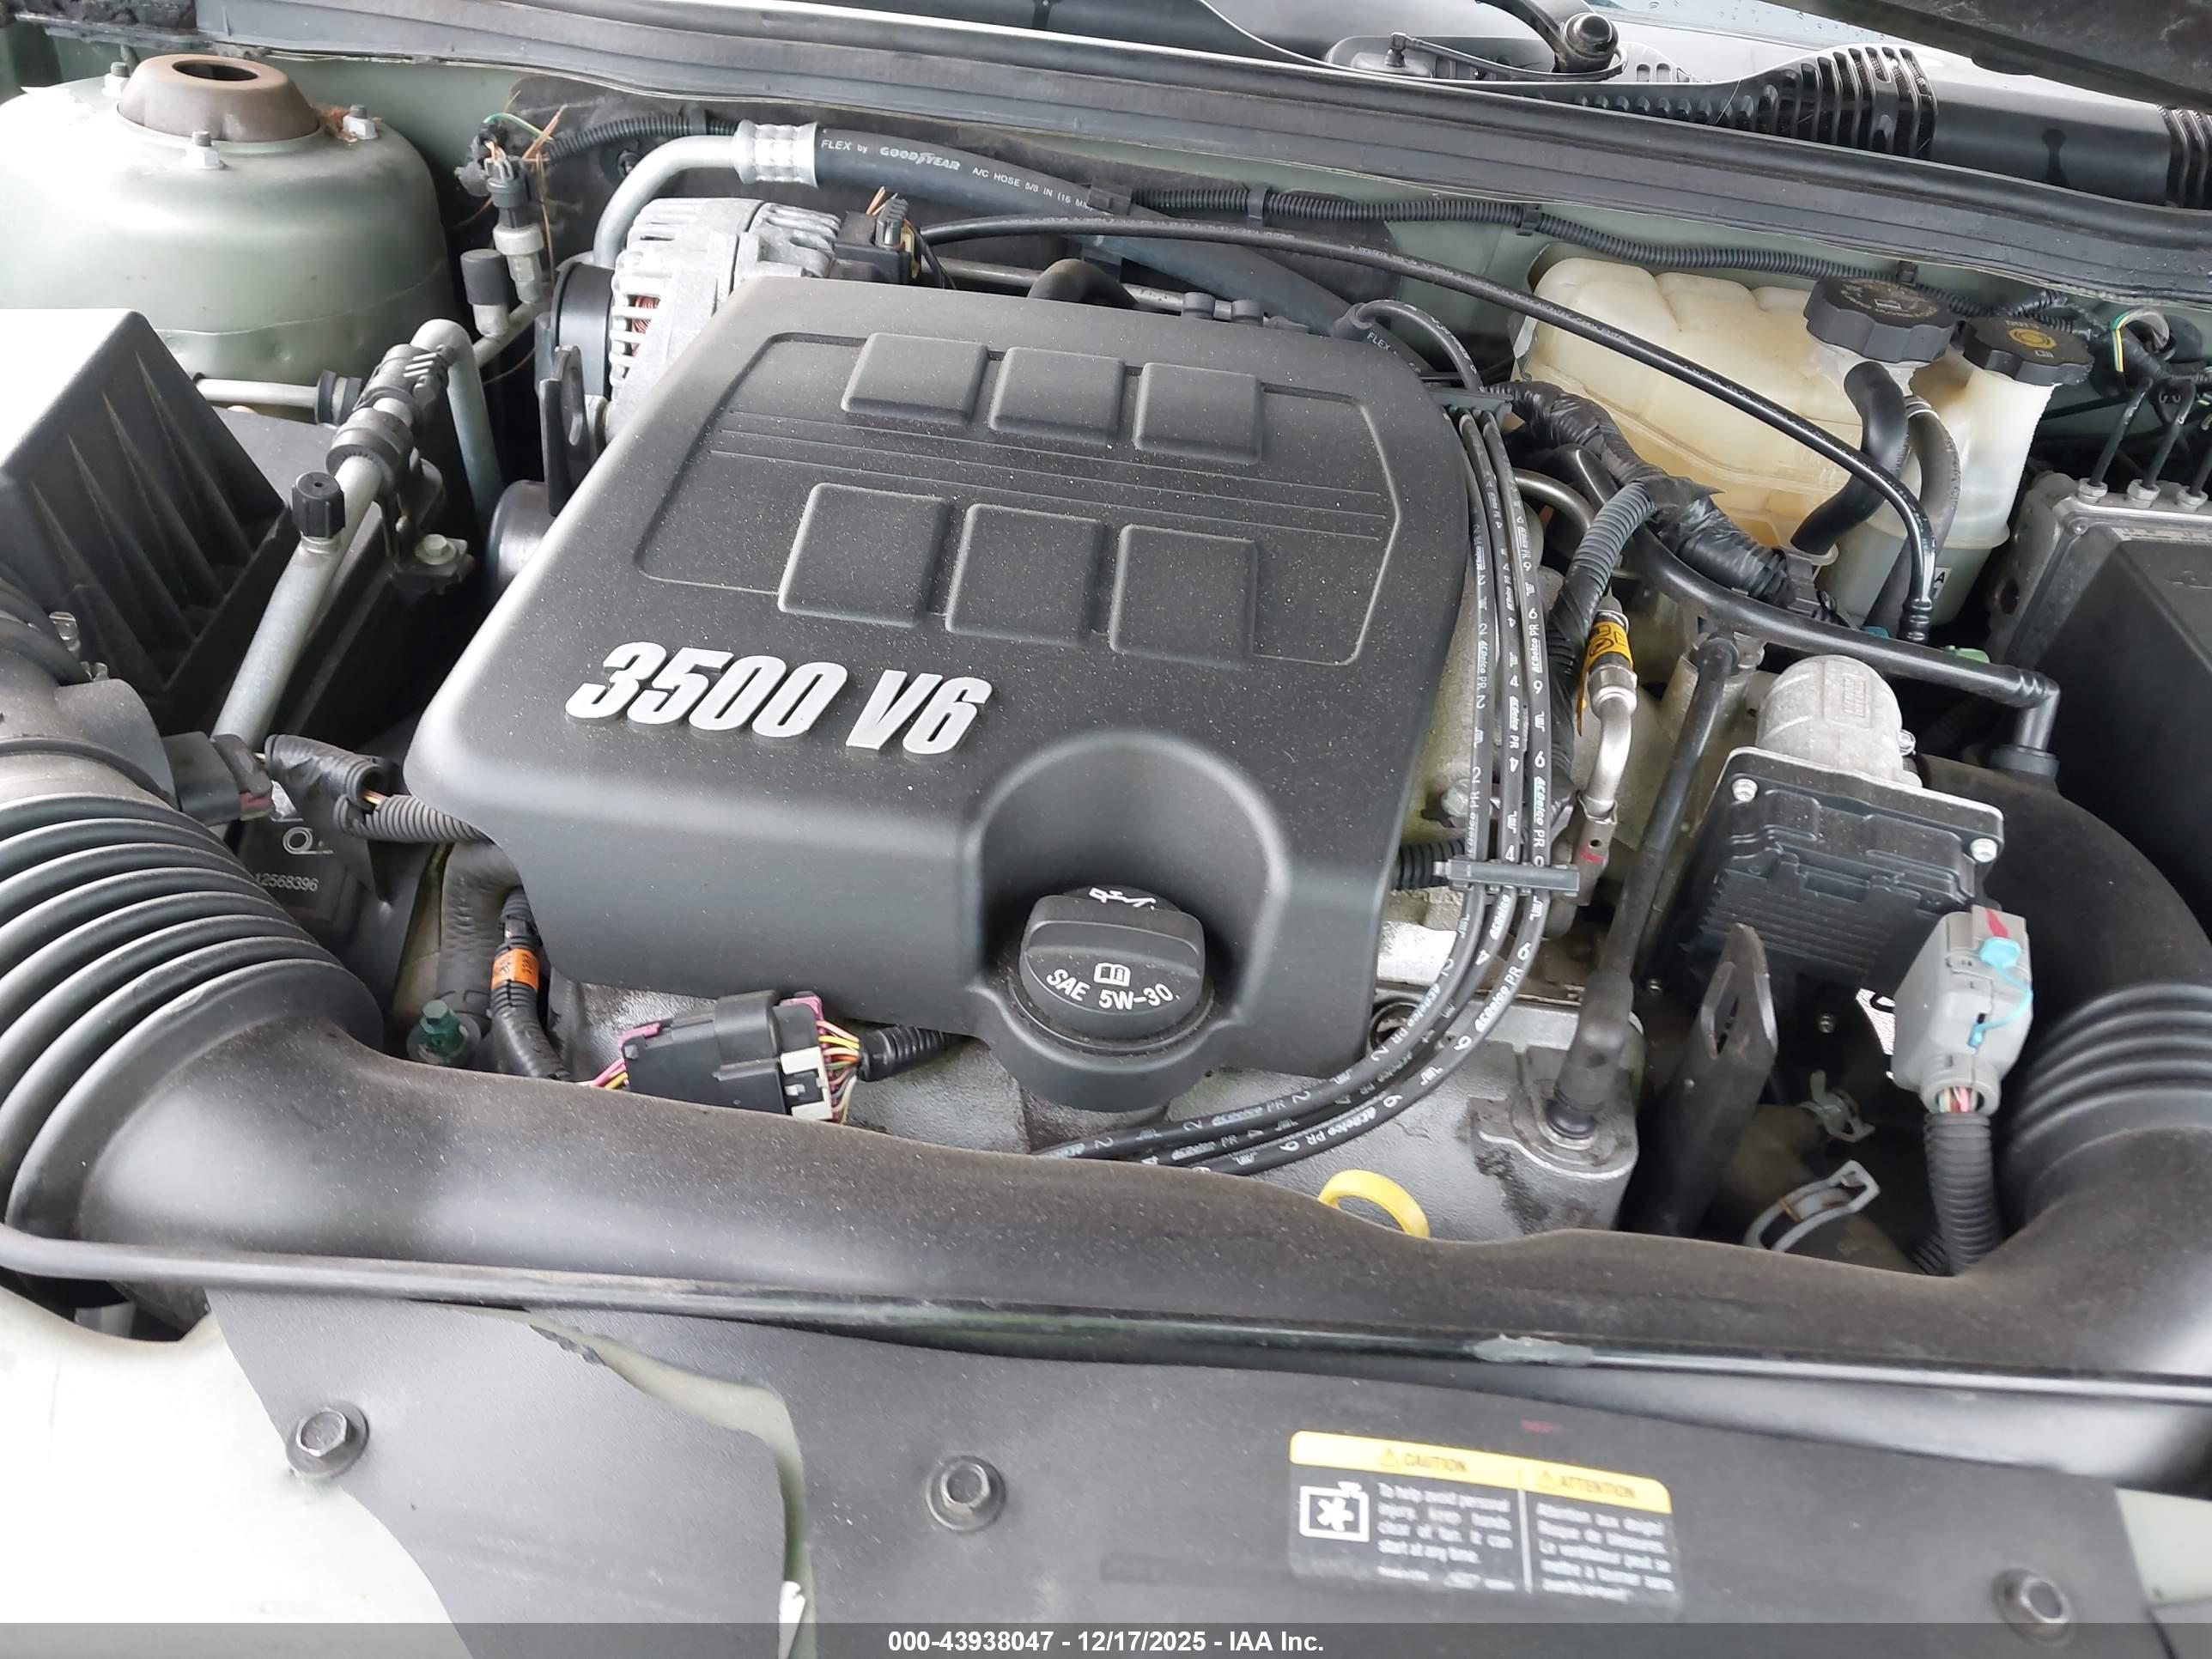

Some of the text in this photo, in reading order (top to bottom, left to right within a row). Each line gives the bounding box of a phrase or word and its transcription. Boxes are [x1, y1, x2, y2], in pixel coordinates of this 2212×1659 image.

[821, 139, 852, 151] FLEX
[857, 143, 868, 155] by
[879, 146, 961, 171] GOODYEAR
[972, 167, 989, 178] A/C
[993, 173, 1021, 187] HOSE
[1024, 182, 1039, 192] 5/8
[1043, 187, 1053, 198] IN
[1366, 331, 1391, 351] FLEX
[1528, 607, 1538, 619] 6
[1479, 623, 1488, 635] 2
[1528, 623, 1540, 635] PR
[1477, 640, 1489, 674] ACDelco
[1530, 637, 1543, 673] ACDelco
[1477, 676, 1487, 690] PR
[1510, 674, 1519, 688] 4
[565, 641, 993, 756] 3500 V6
[1509, 696, 1520, 732] ACDelco
[1510, 734, 1519, 749] PR
[1534, 750, 1546, 769] 6
[1471, 766, 1482, 784] 2
[1469, 790, 1480, 808] PR
[1534, 775, 1547, 826] ACDelco
[1533, 829, 1546, 848] PR
[1046, 969, 1091, 1001] SAE
[1474, 942, 1533, 1033] ACDelco PR 6
[1389, 1026, 1409, 1044] PR
[1266, 1098, 1286, 1113] PR
[1327, 1106, 1376, 1137] ACDelco
[1305, 1129, 1327, 1146] PR
[1404, 1453, 1468, 1474] CAUTION
